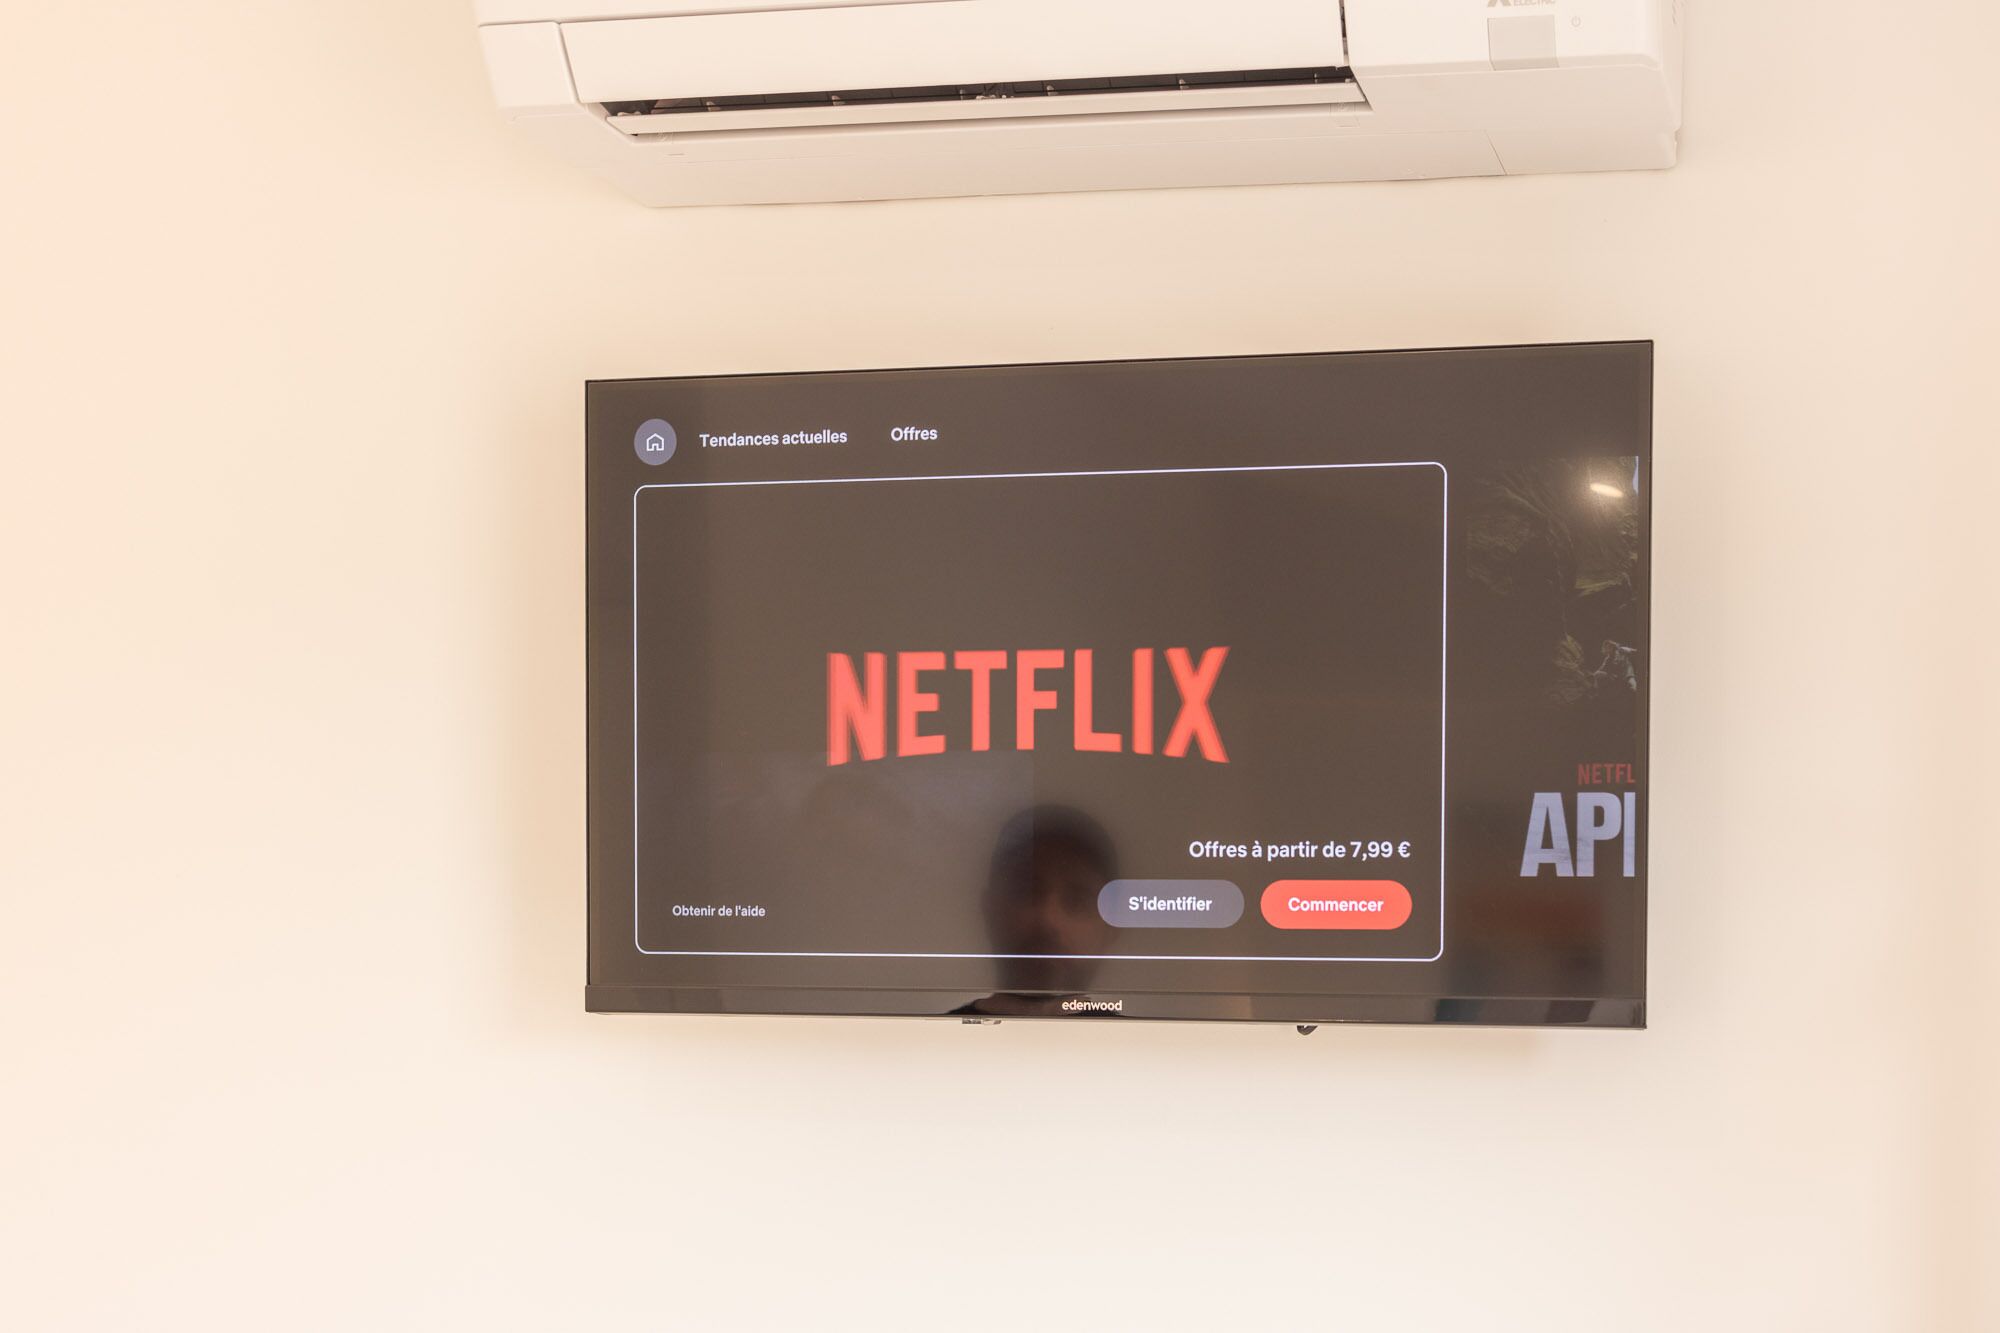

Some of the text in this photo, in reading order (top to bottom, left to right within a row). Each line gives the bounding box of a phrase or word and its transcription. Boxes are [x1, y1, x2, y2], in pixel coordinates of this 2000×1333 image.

[699, 429, 848, 449] Tendances actuelles
[890, 426, 938, 442] Offres
[826, 646, 1231, 767] NETFLIX
[1188, 840, 1411, 862] Offres à partir de 7,99 €
[672, 904, 766, 917] Obtenir de l'aide
[1128, 895, 1213, 912] S'identifier
[1287, 896, 1385, 913] Commencer
[1061, 999, 1123, 1011] edenwood
